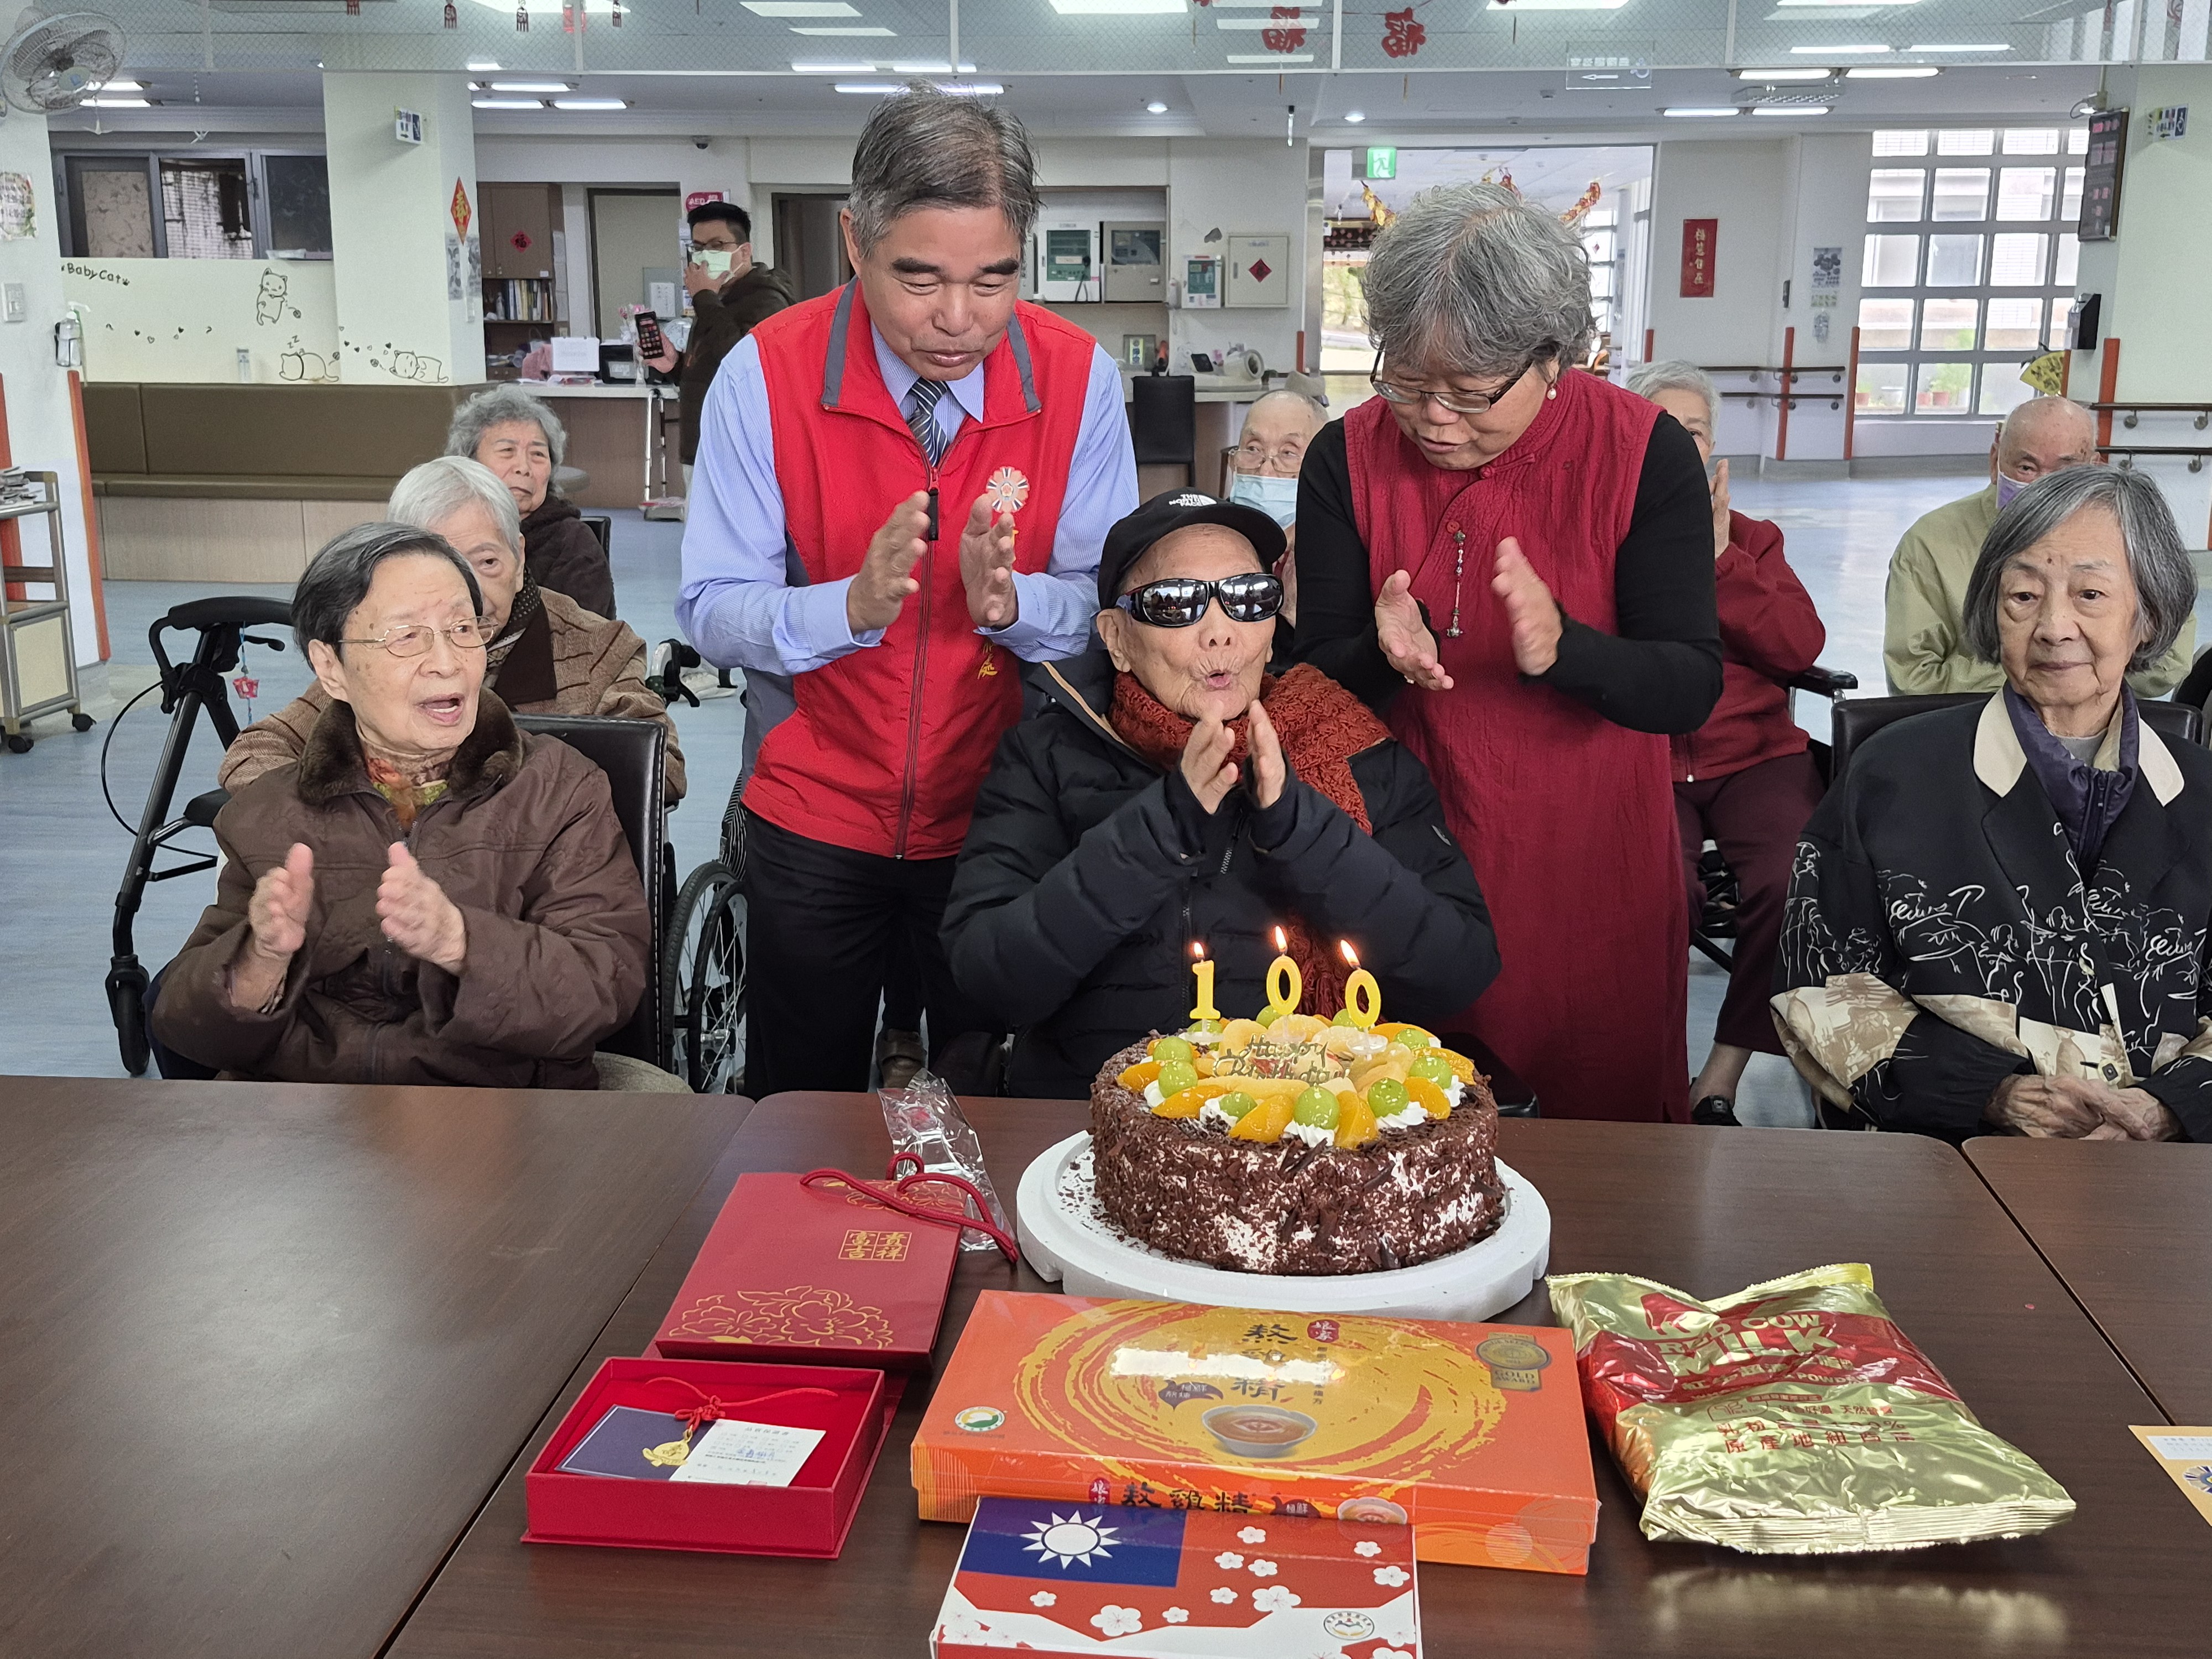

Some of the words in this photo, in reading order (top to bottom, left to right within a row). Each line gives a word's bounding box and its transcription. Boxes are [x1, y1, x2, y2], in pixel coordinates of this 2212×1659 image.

[849, 1232, 907, 1245] 富貴
[844, 1245, 902, 1260] 吉祥
[1740, 1314, 1824, 1329] COW
[1662, 1327, 1841, 1377] MILK
